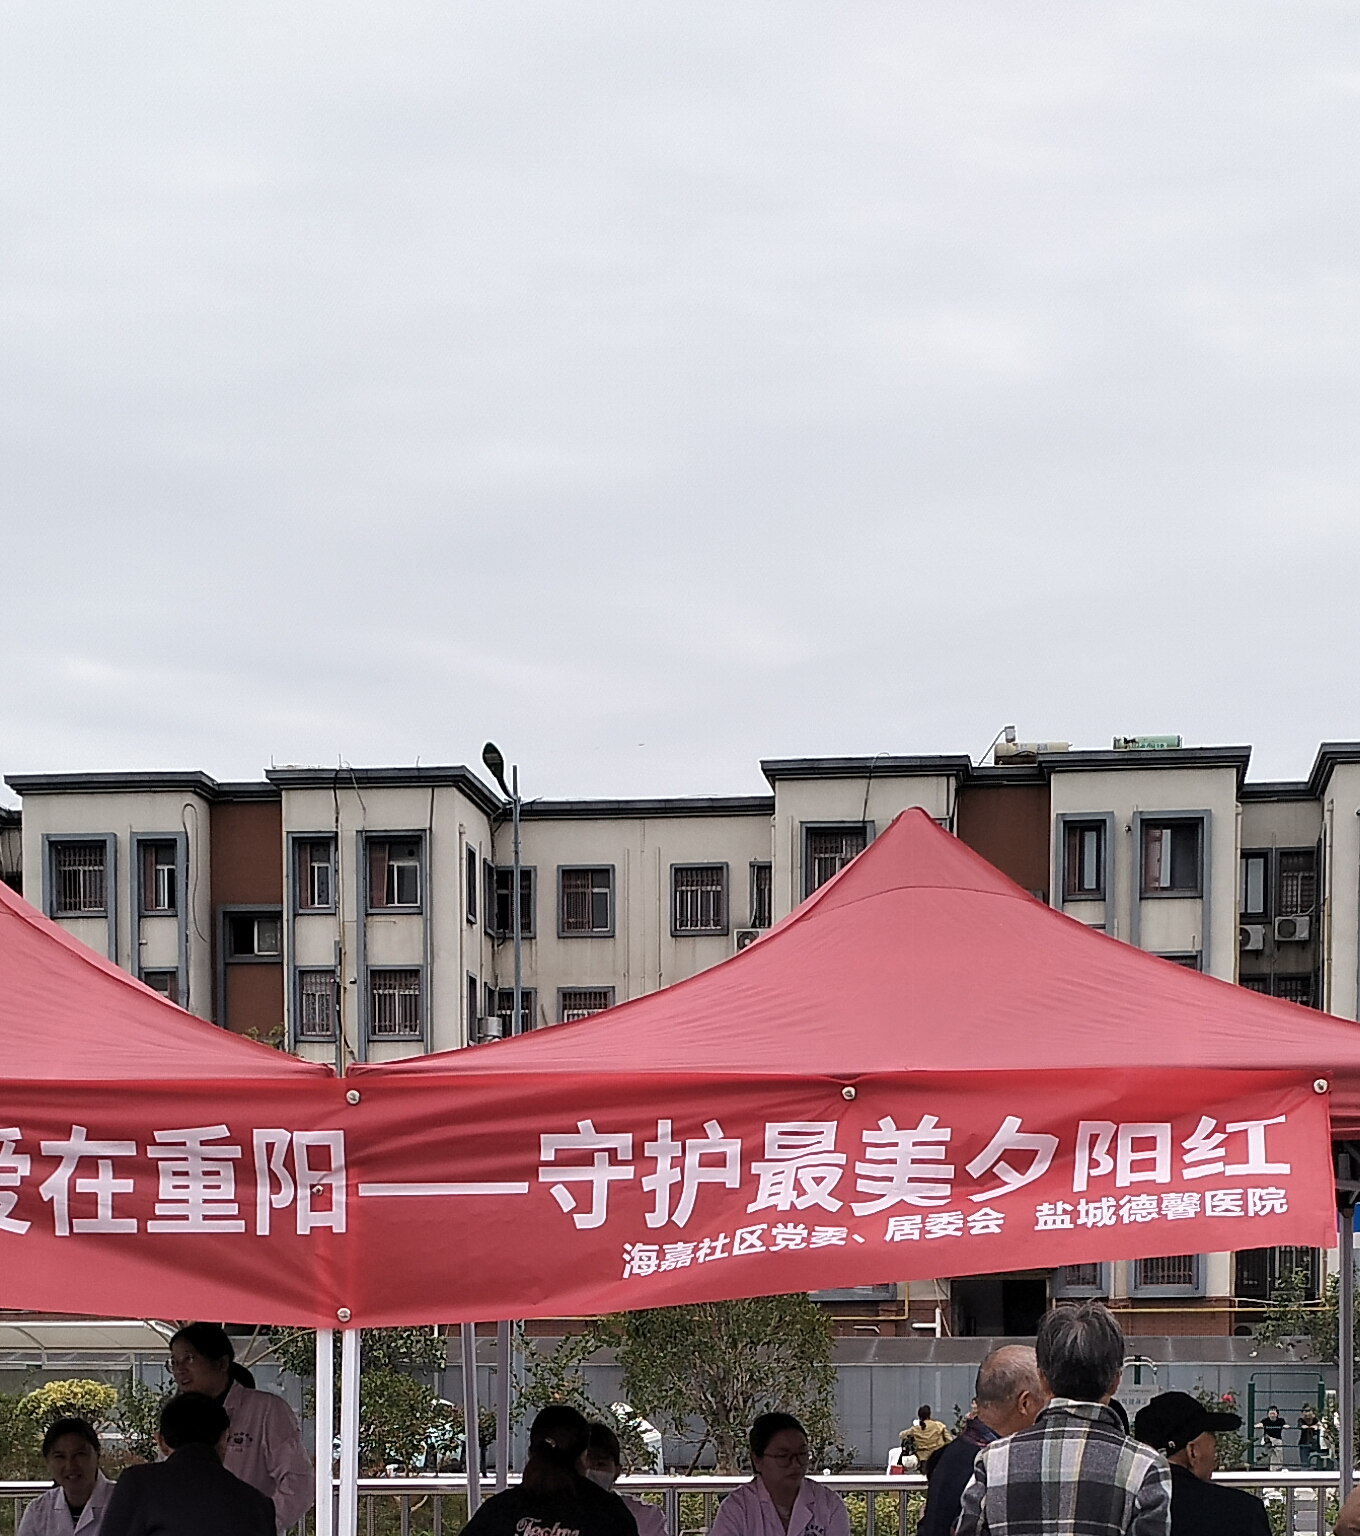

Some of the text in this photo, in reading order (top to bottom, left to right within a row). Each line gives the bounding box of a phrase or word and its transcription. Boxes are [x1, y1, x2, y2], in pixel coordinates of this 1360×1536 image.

[621, 1186, 1288, 1279] 海嘉社区党委、居委会 盐城德馨医院
